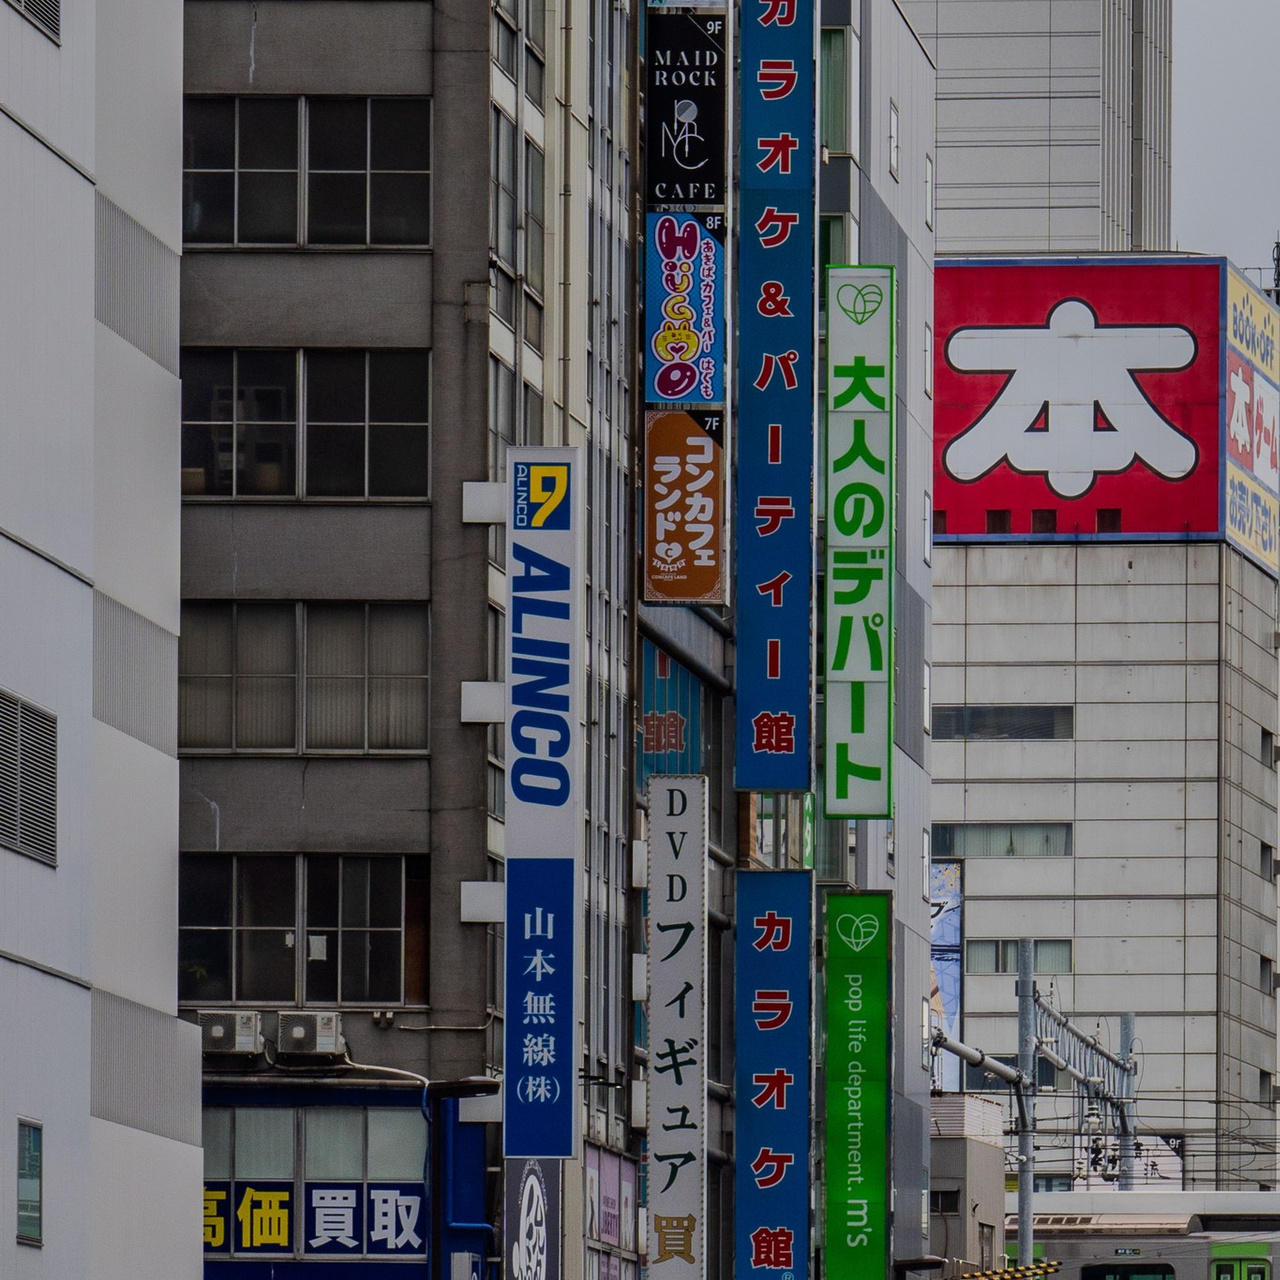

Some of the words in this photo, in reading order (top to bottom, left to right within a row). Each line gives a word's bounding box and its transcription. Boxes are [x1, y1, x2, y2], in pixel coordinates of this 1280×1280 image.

[655, 50, 718, 66] MAID
[707, 21, 722, 35] 9F
[655, 70, 717, 86] ROCK
[655, 183, 716, 199] CAFE
[706, 216, 721, 230] 8F
[705, 417, 720, 431] 7F
[943, 298, 1199, 500] 本
[1230, 367, 1251, 456] 本
[515, 465, 527, 527] ALINCO
[653, 456, 682, 541] ランド
[685, 436, 716, 566] コンカフェ
[831, 356, 885, 800] 大人のデパート
[510, 542, 571, 808] ALINCO
[516, 906, 561, 1104] 山本無線(株)
[844, 974, 862, 1012] pop
[847, 1019, 866, 1054] life
[750, 912, 795, 1270] カラオケ館
[844, 1061, 866, 1192] department.
[846, 1198, 868, 1248] m's
